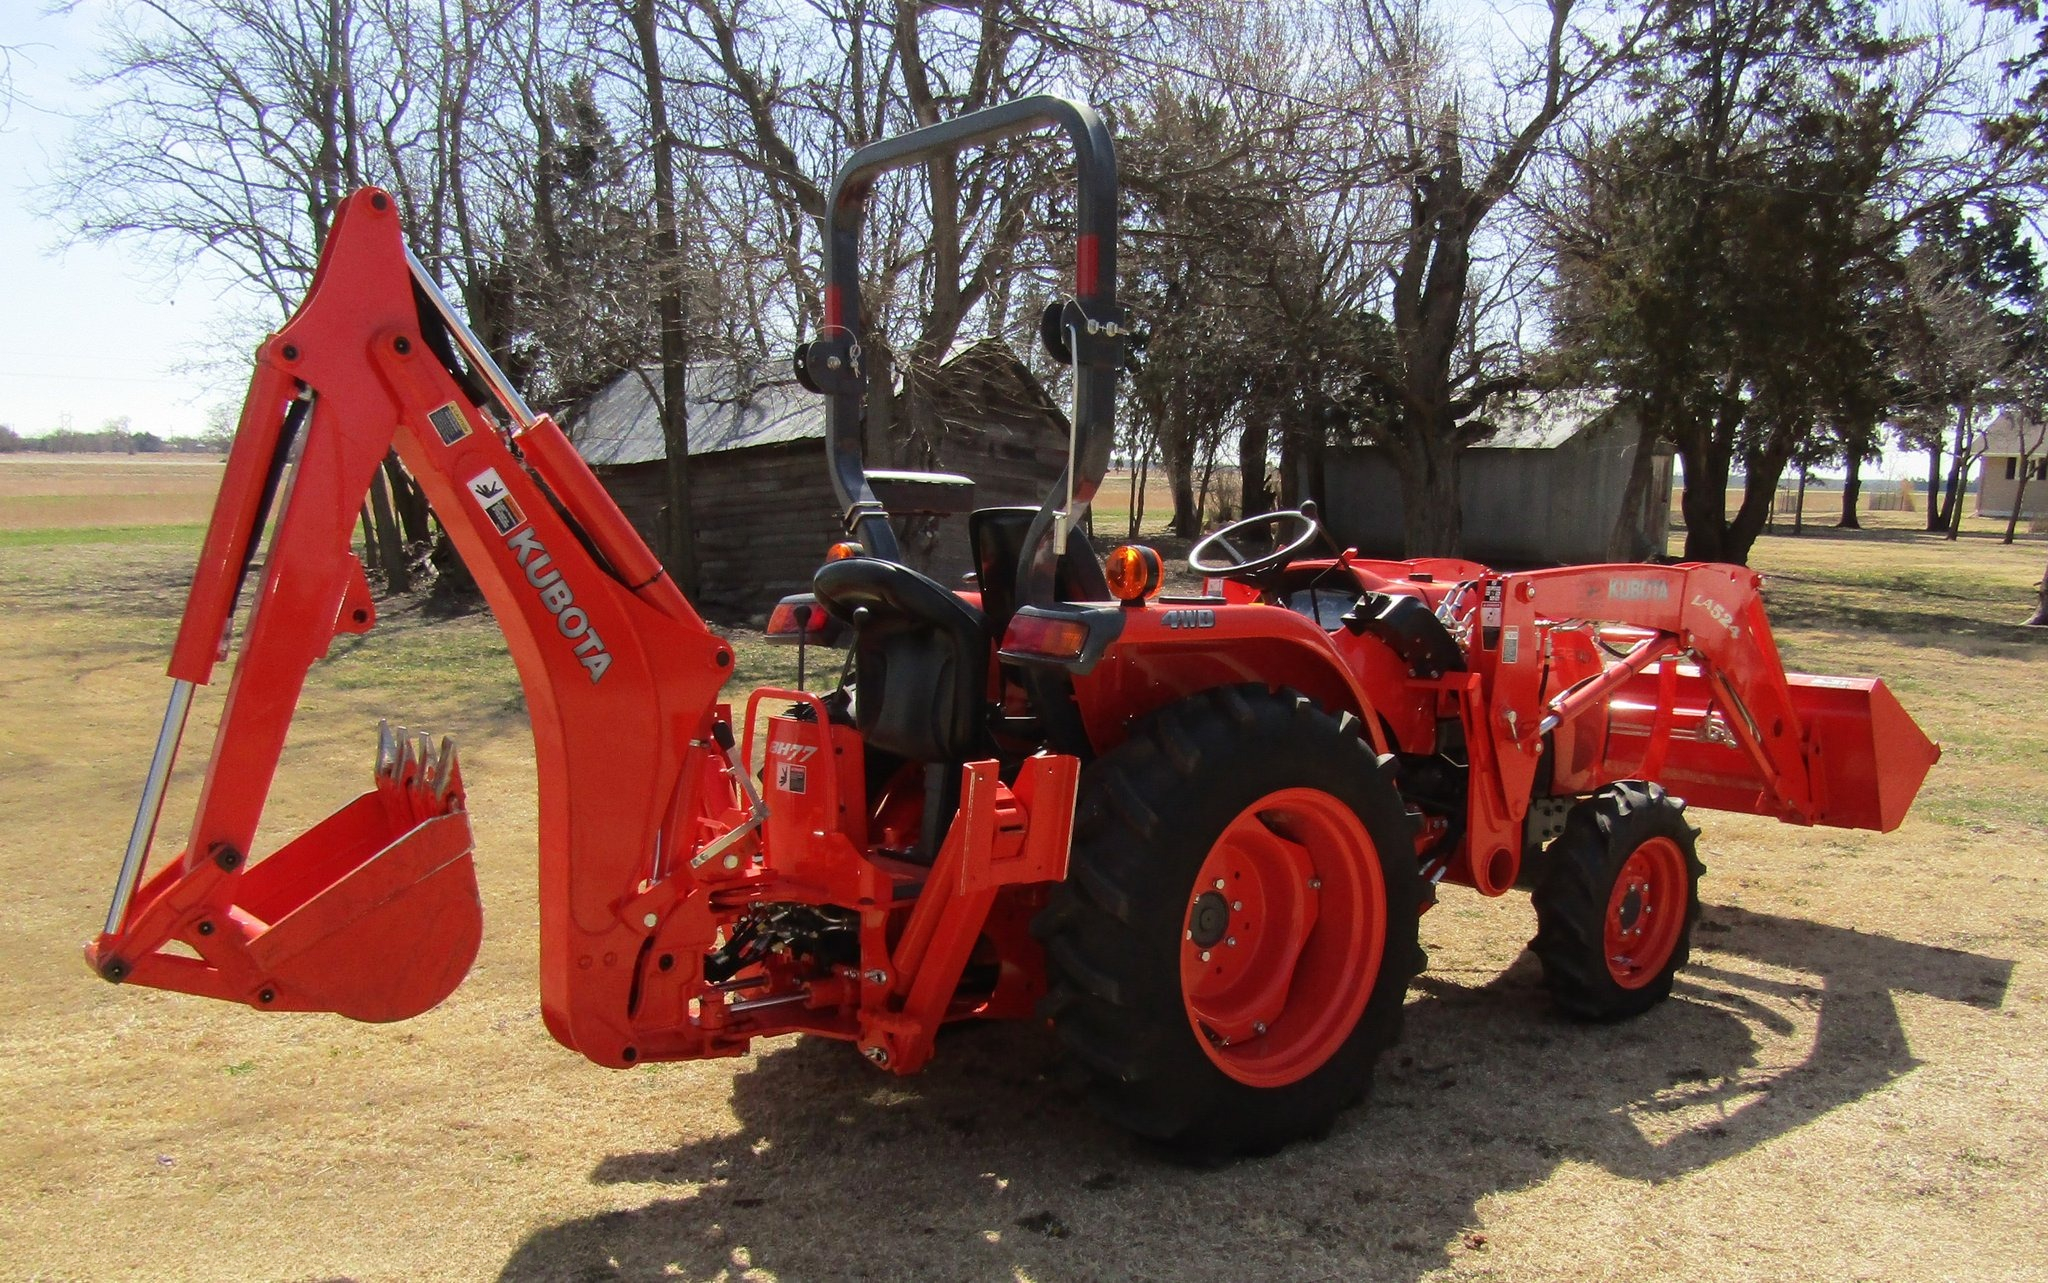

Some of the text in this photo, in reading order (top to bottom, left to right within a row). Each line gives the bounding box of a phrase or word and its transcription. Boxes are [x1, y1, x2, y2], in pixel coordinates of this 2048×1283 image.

[507, 526, 614, 685] KUBOTA
[1608, 578, 1669, 600] KUBOTA
[1161, 609, 1216, 630] 4WD
[1690, 594, 1740, 639] LA524
